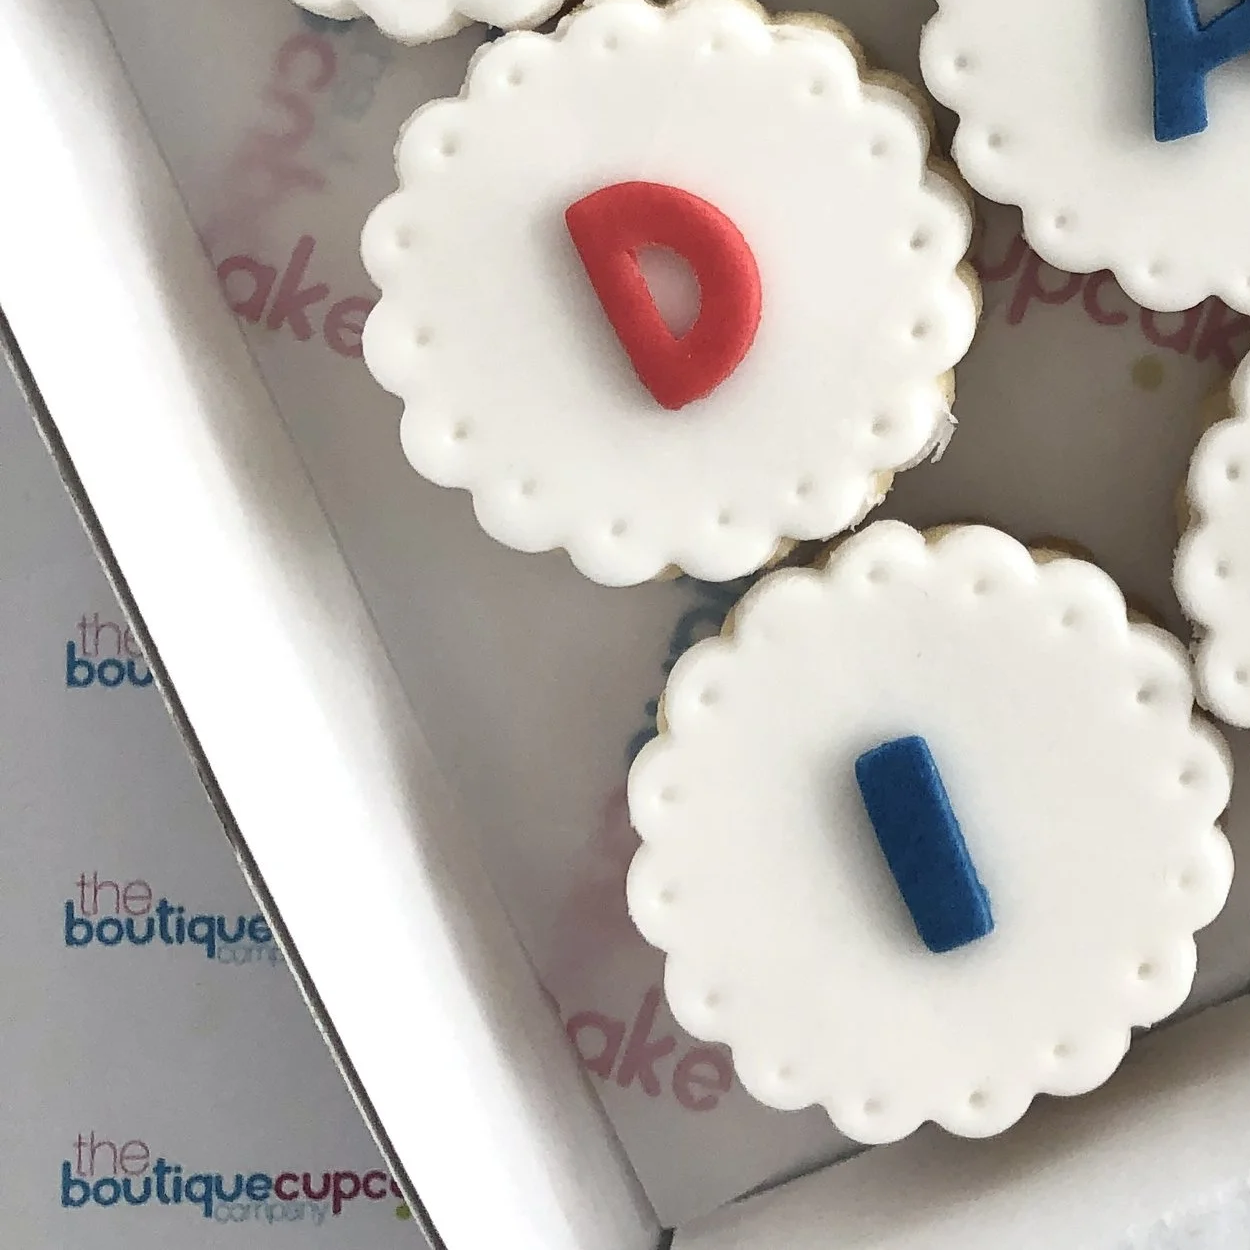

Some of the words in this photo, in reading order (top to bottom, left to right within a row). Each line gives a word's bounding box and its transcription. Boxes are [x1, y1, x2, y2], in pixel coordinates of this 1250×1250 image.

[566, 182, 762, 410] D
[74, 871, 153, 916] the
[856, 736, 995, 954] I
[73, 1130, 151, 1177] the
